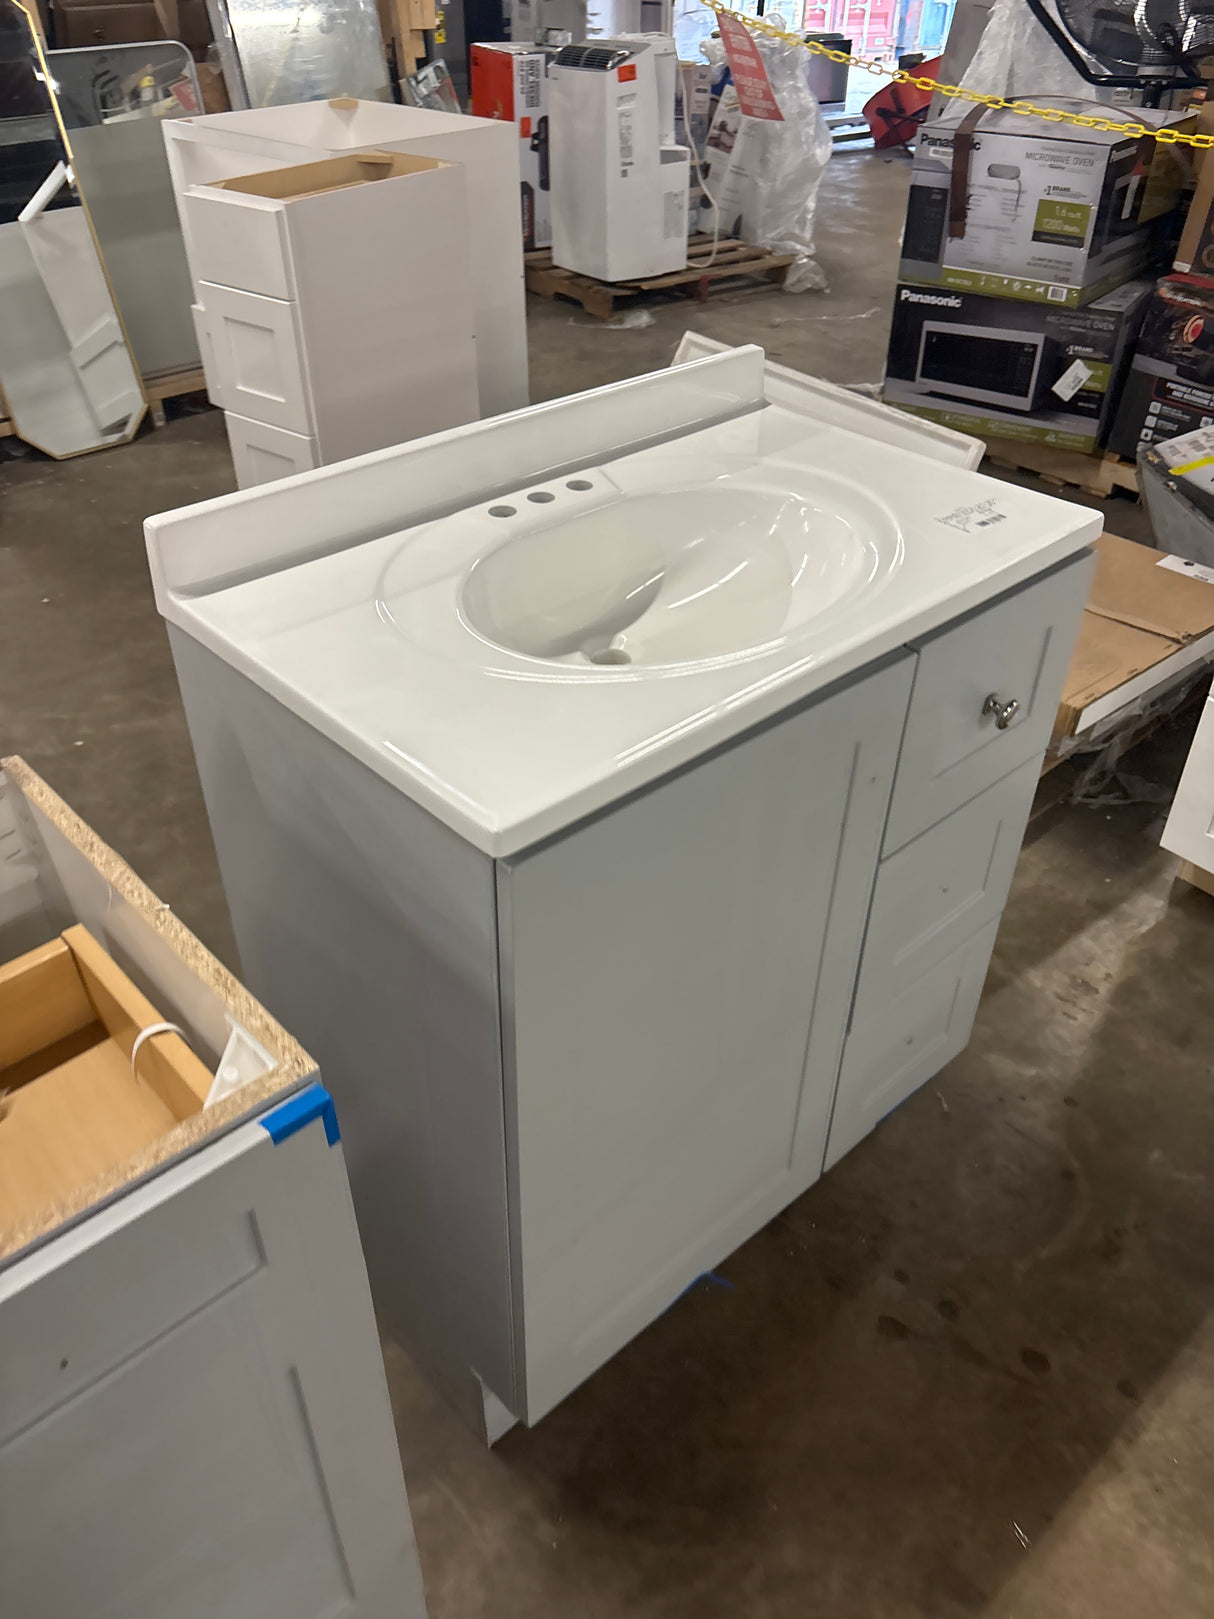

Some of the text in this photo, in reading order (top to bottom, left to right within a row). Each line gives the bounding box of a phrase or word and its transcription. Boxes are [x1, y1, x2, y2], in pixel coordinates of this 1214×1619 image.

[1025, 152, 1095, 167] MICROWAVE OVEN
[900, 289, 962, 308] Panasonic
[1093, 320, 1115, 331] OVEN
